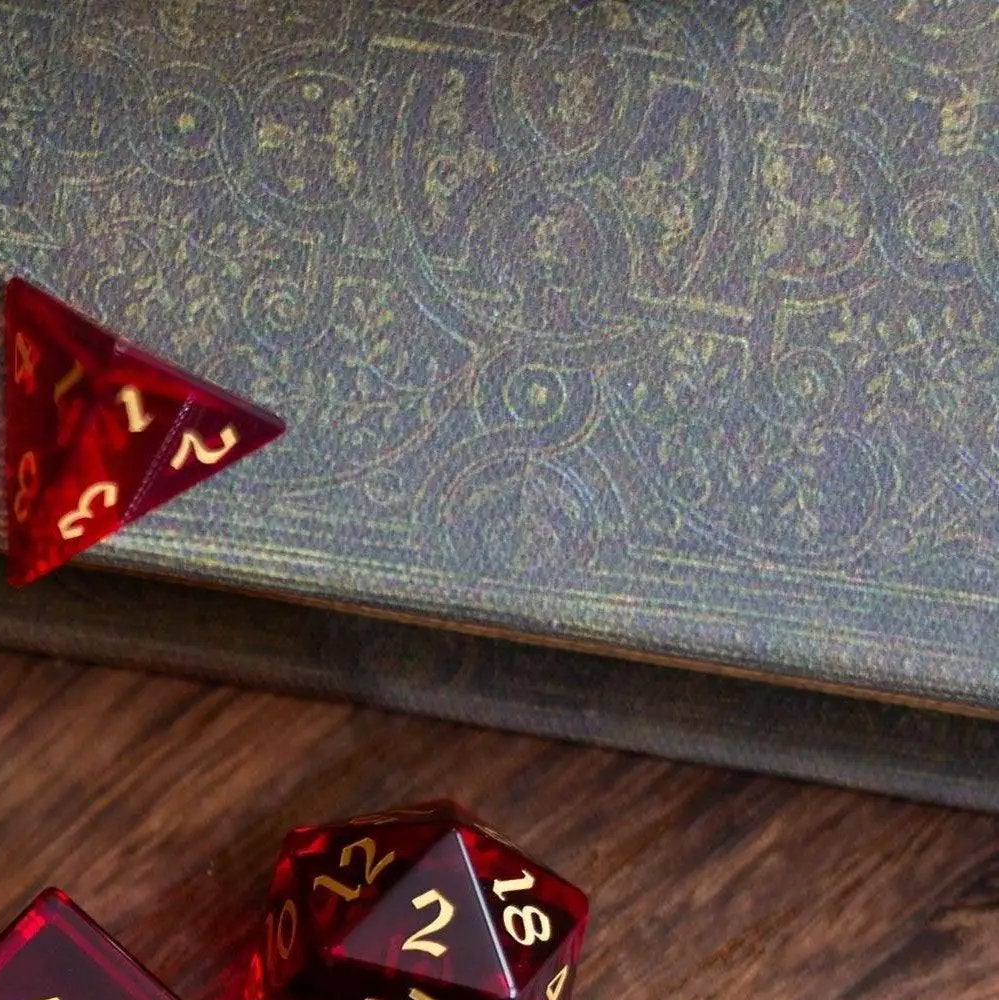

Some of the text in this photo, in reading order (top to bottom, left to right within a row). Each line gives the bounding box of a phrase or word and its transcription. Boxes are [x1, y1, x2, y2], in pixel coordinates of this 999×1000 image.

[118, 386, 152, 432] 1
[171, 425, 238, 470] 2
[57, 481, 117, 540] 3
[313, 837, 394, 901] 12
[402, 889, 454, 957] 2
[493, 869, 551, 946] 18
